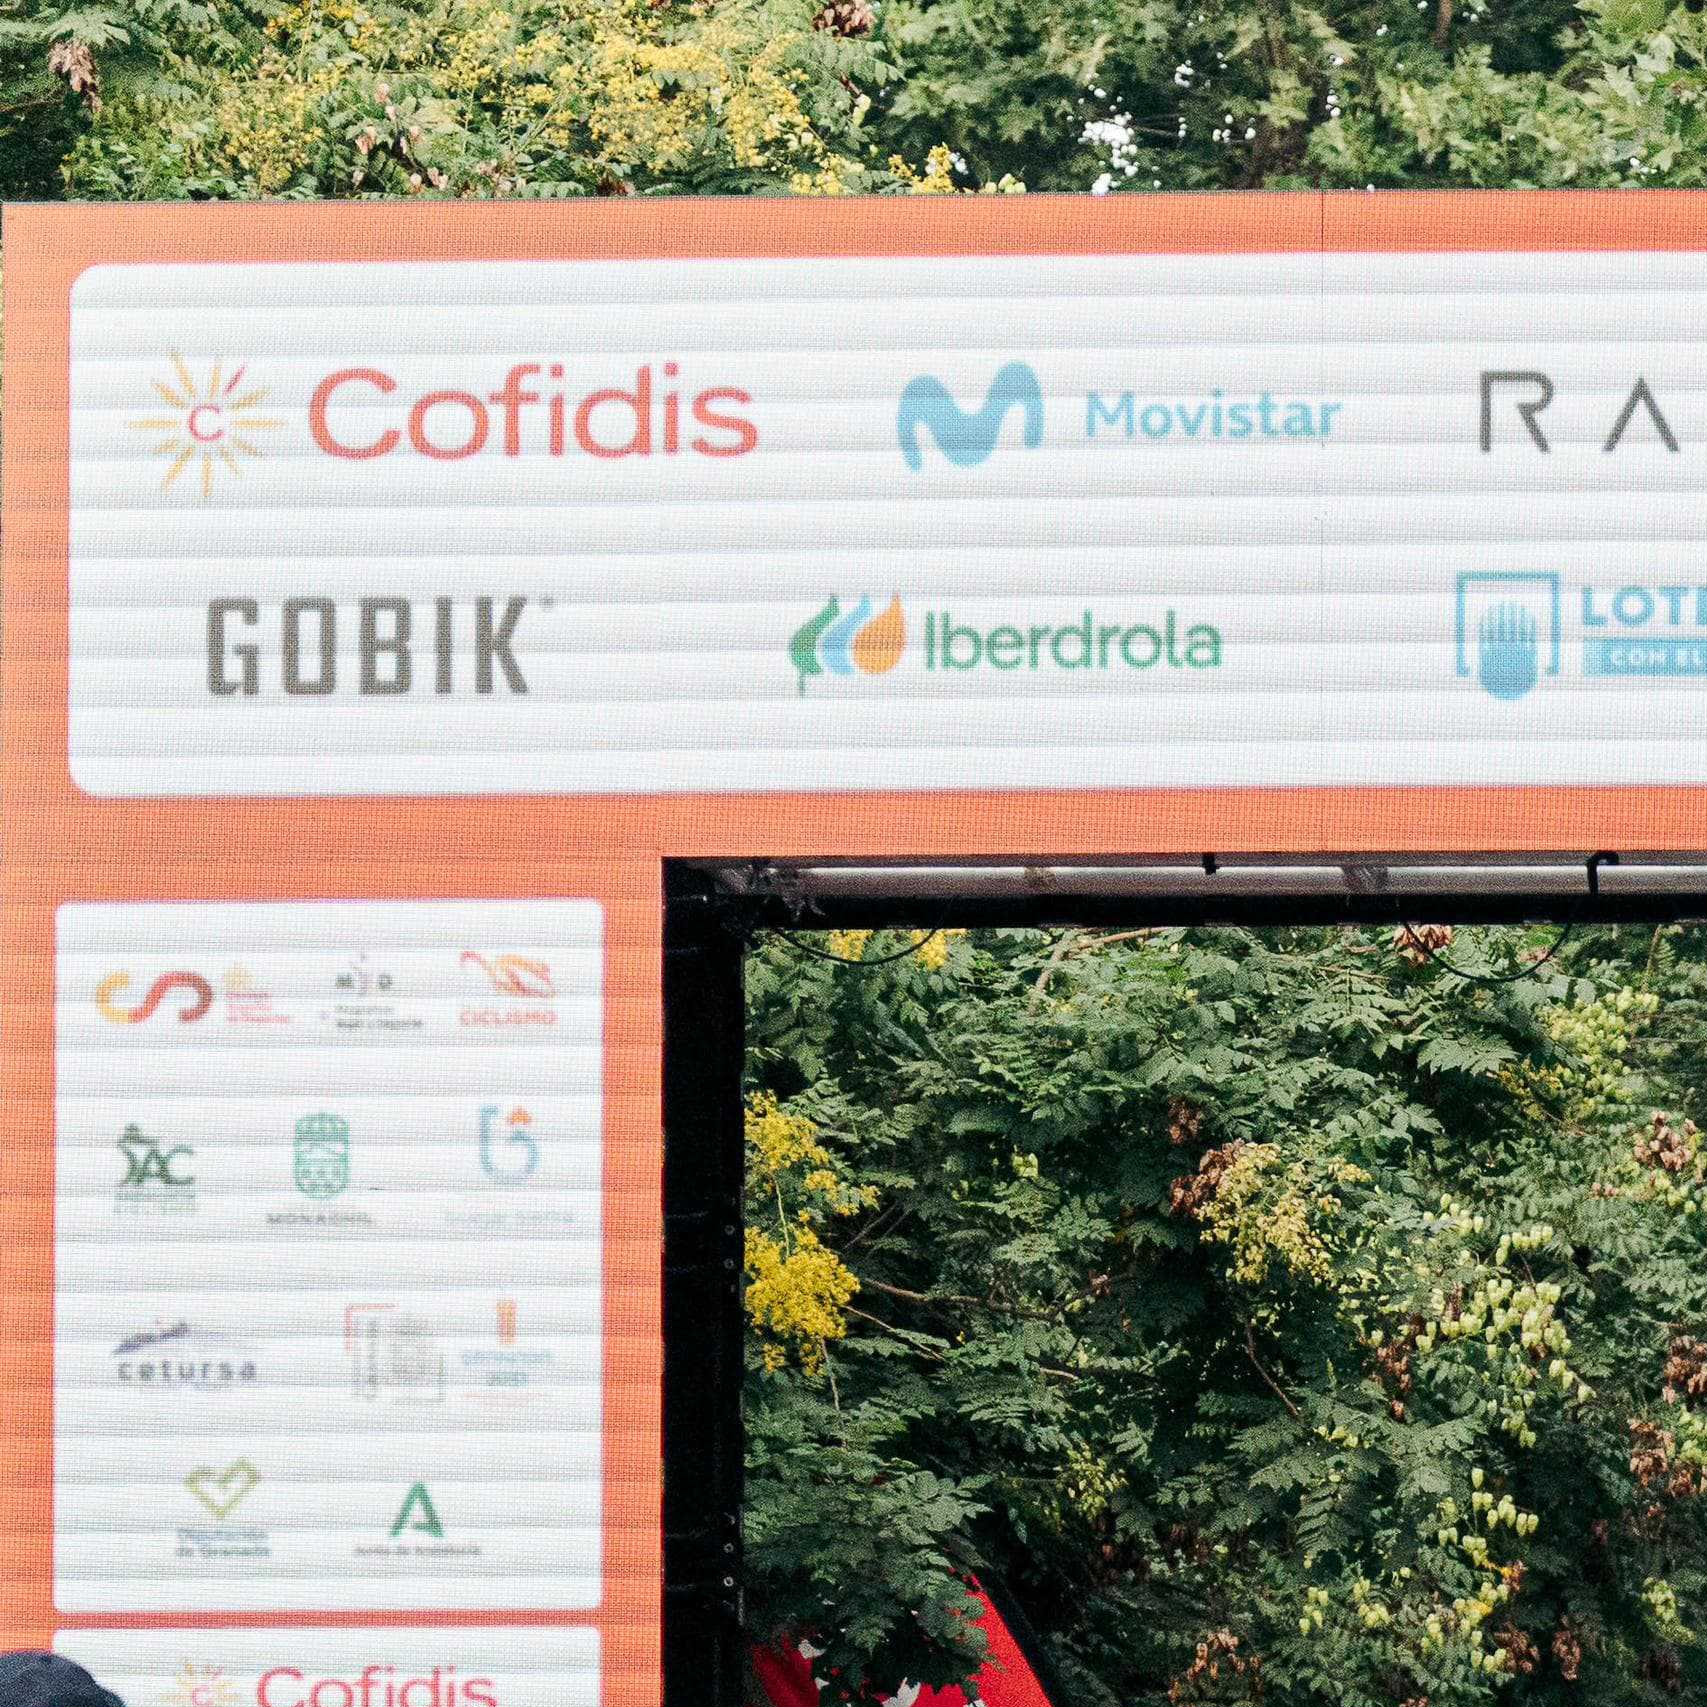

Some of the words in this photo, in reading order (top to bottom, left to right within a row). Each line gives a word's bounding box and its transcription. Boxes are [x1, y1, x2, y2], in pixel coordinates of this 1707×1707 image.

[307, 361, 761, 460] Cofidis
[1083, 389, 1343, 439] Movistar
[206, 596, 530, 696] GOBIK
[924, 610, 1223, 673] Iberdrola
[1608, 646, 1669, 668] CON
[1676, 646, 1706, 668] EL
[117, 1359, 258, 1382] cetursa
